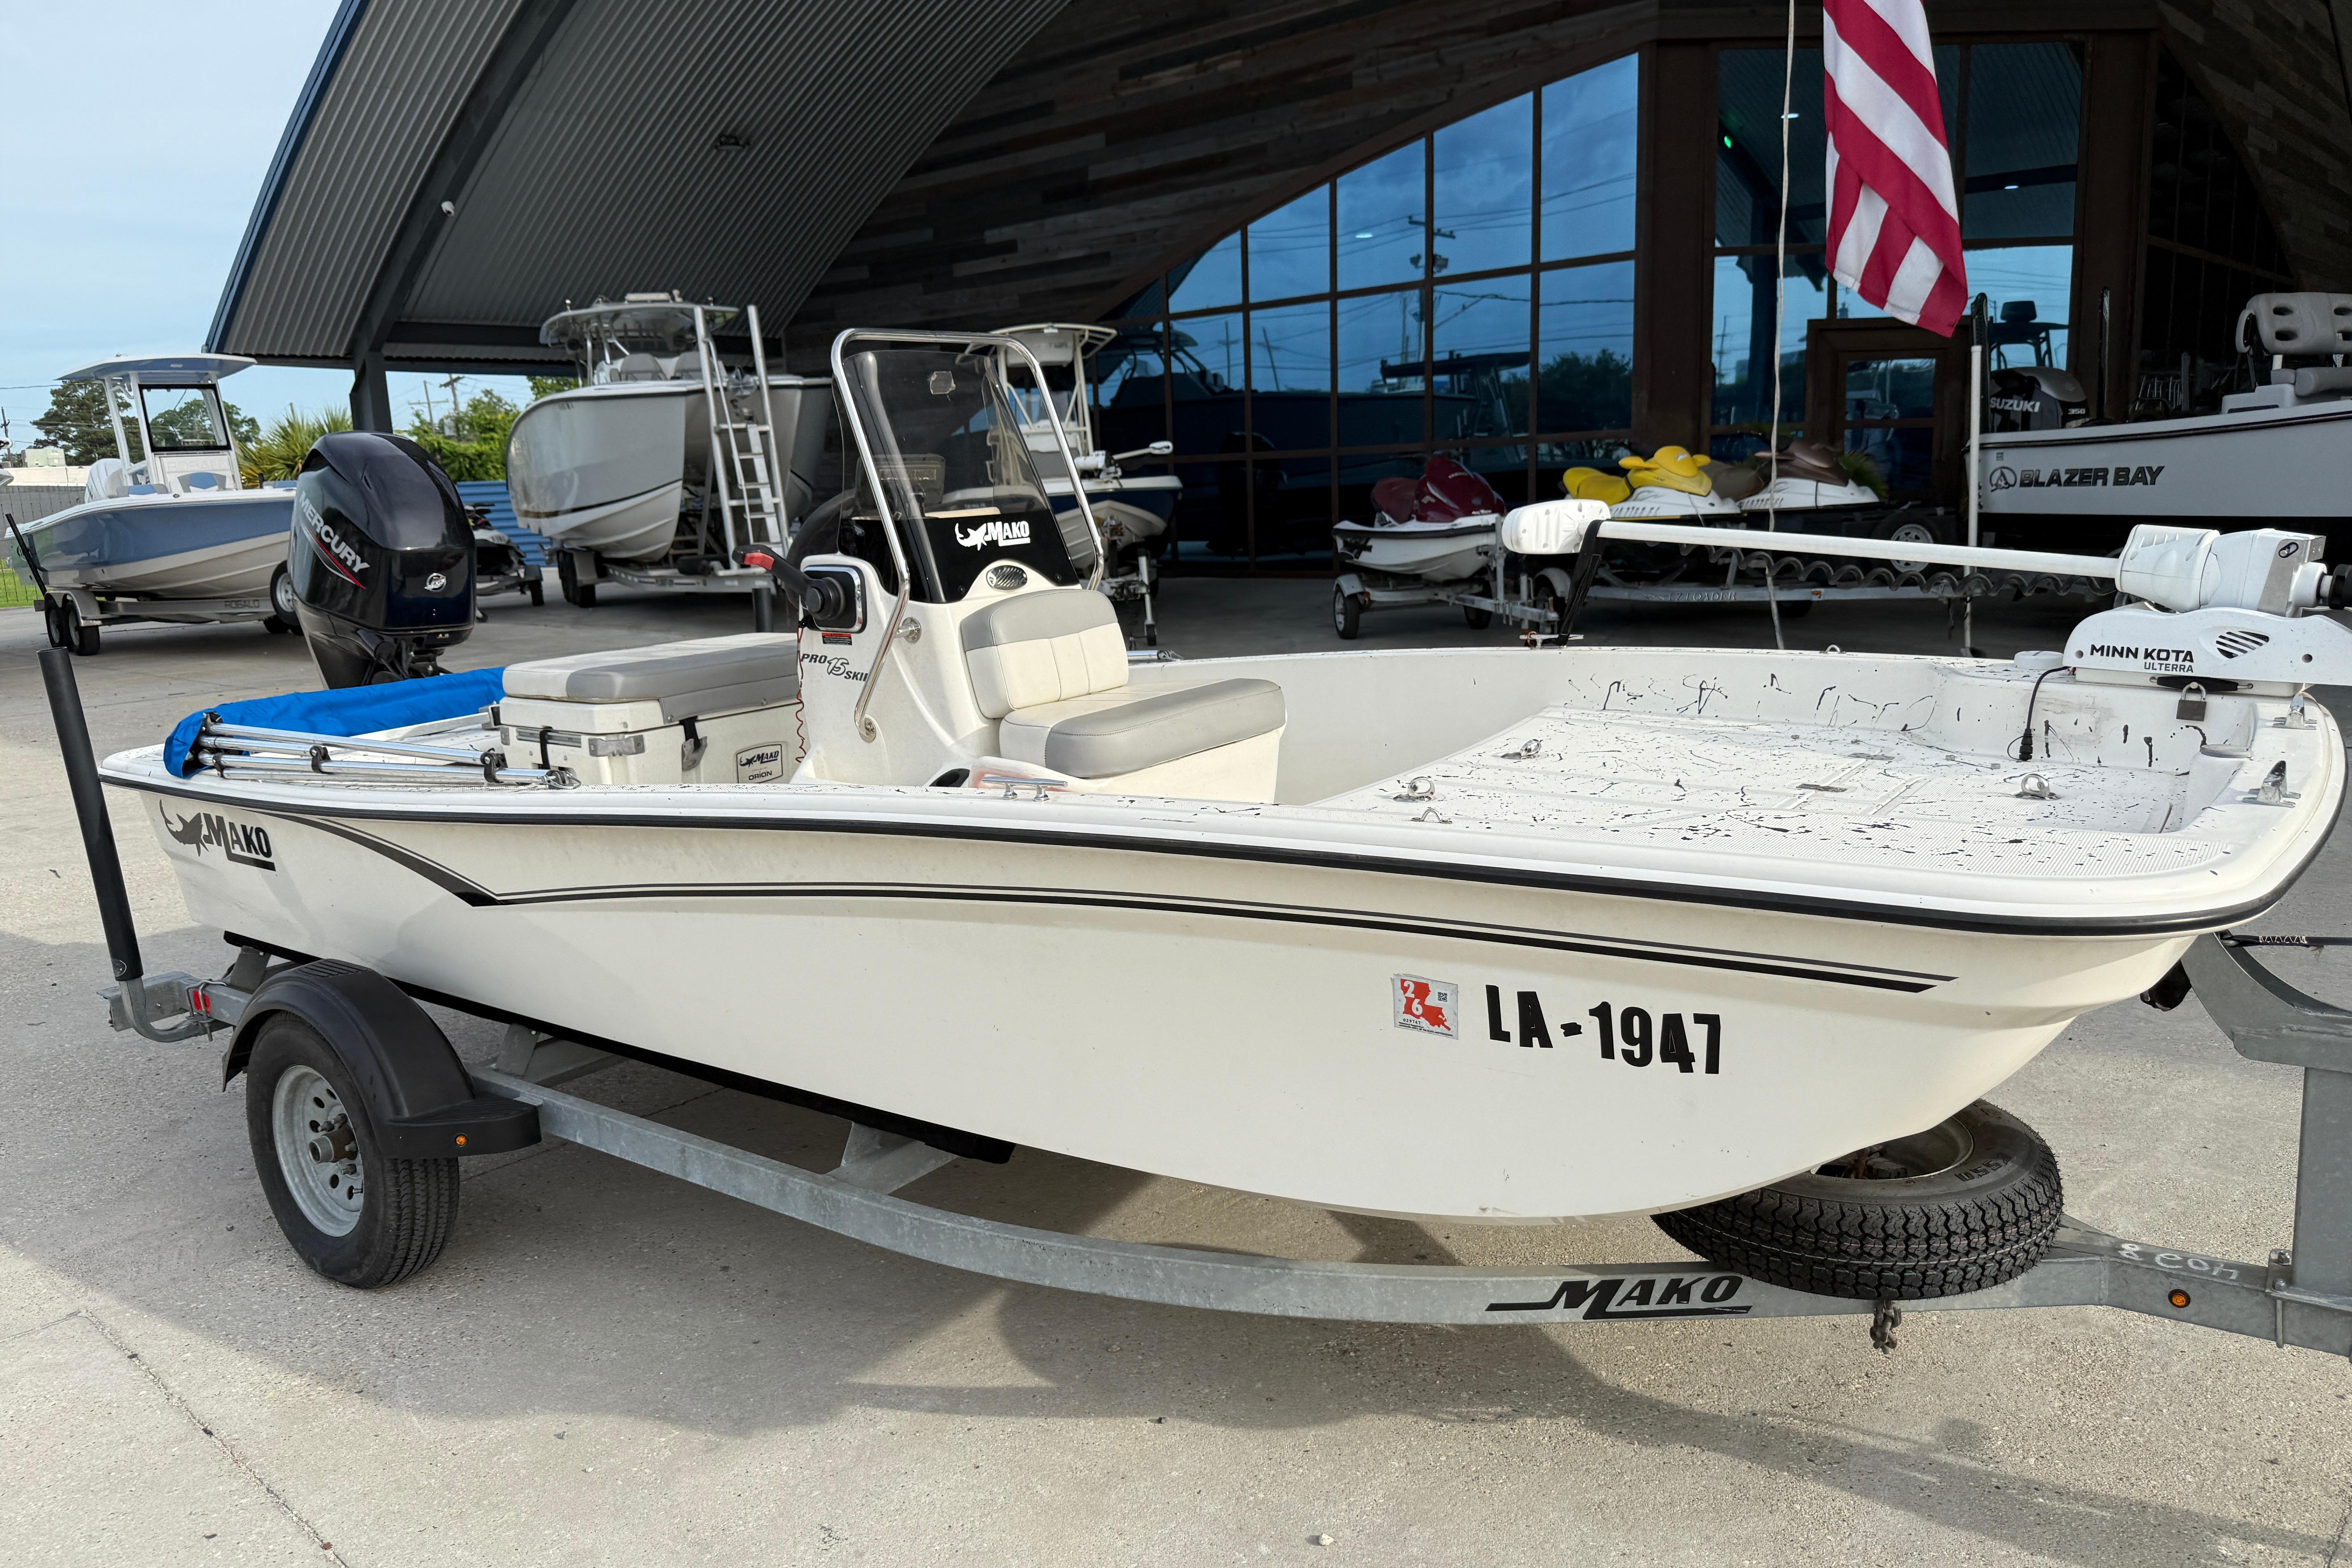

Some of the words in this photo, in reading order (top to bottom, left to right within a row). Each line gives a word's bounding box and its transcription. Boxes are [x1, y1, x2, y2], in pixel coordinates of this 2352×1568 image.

[1990, 397, 2040, 412] SUZUKI
[2019, 468, 2109, 488] BLAZER
[2113, 466, 2165, 486] BAY
[299, 491, 370, 573] MERCURY
[984, 520, 1031, 547] MAKO
[800, 653, 828, 663] PRO
[827, 657, 849, 676] 15
[2090, 644, 2139, 659] MINN
[2144, 648, 2194, 663] KOTA
[2144, 662, 2193, 673] ULTERRA
[753, 750, 779, 764] MAKO
[203, 812, 276, 872] MAKO
[1404, 980, 1415, 998] 2
[1412, 999, 1423, 1015] 6
[1485, 984, 1721, 1074] LA-1947
[1485, 1276, 1752, 1320] MAKO
